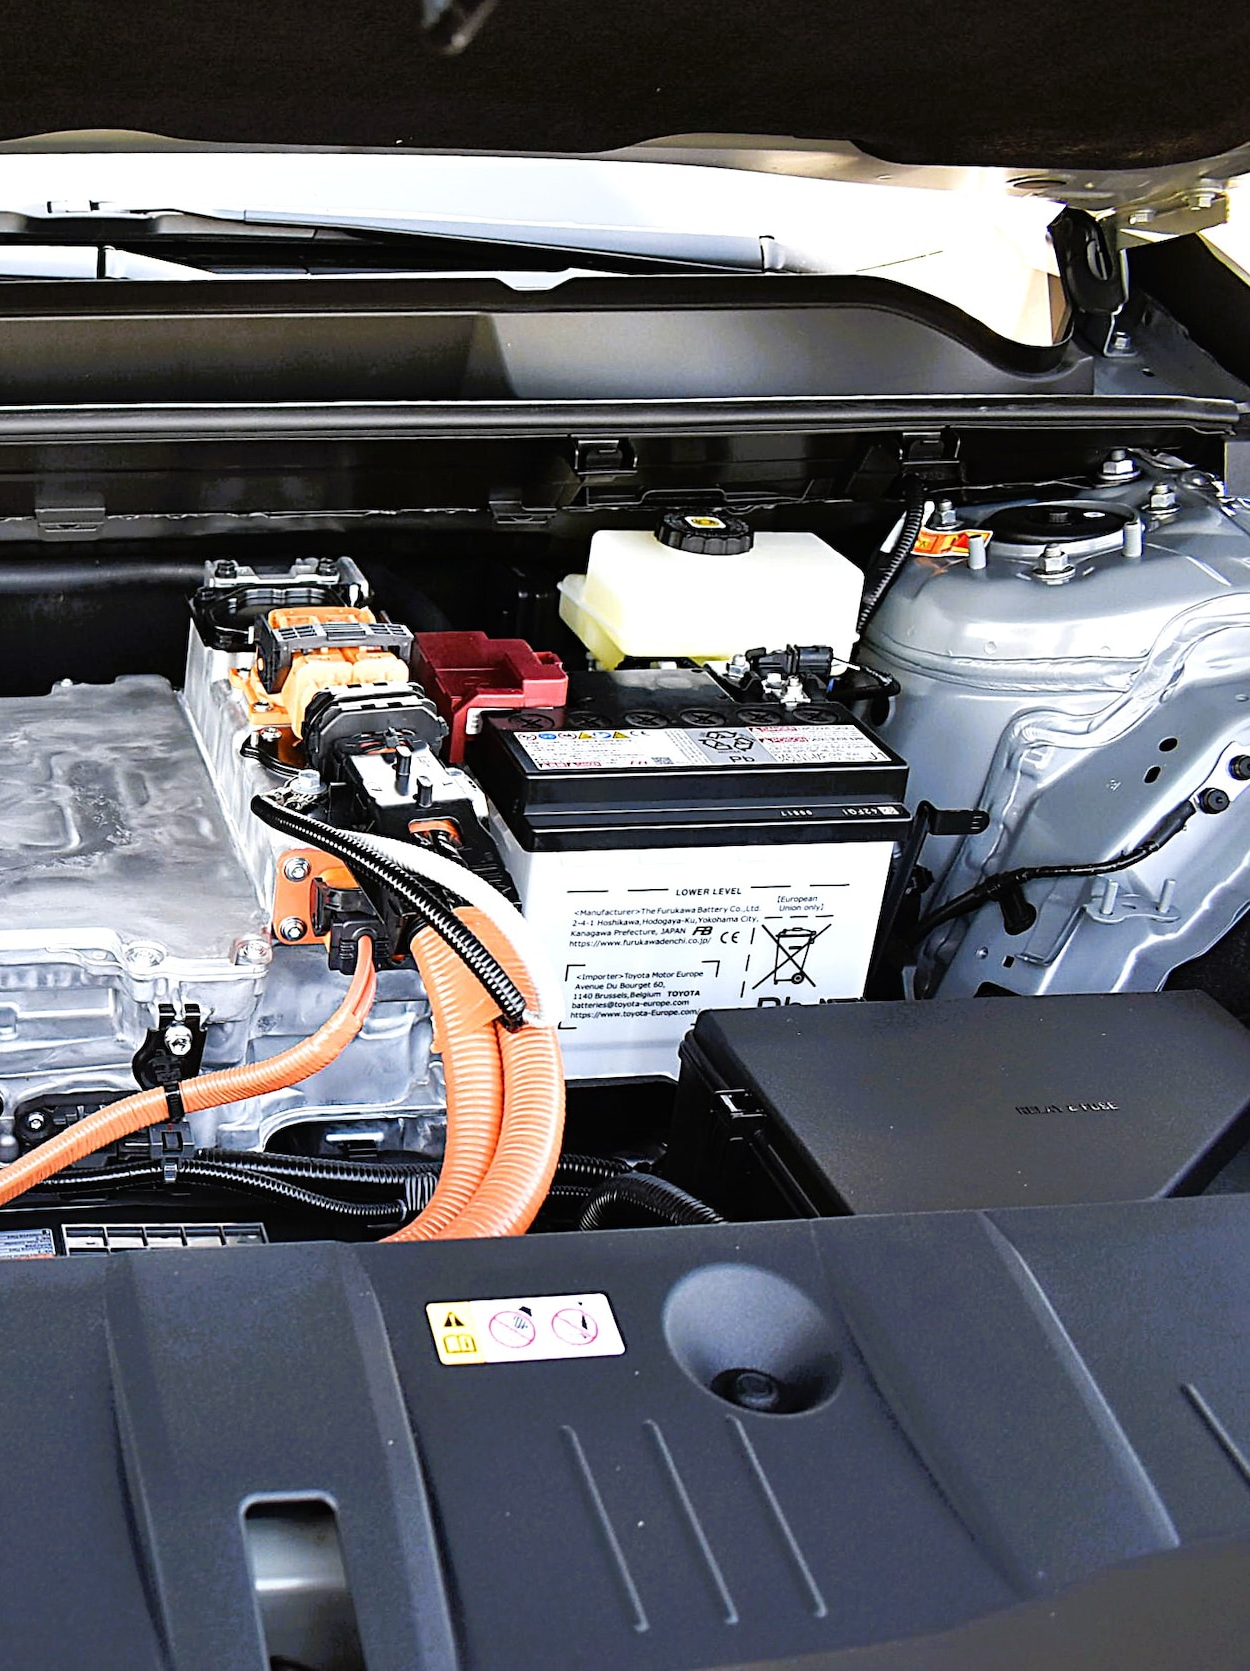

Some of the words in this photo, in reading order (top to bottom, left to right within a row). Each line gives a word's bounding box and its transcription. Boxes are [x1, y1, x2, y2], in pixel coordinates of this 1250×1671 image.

[729, 755, 755, 763] Pb
[720, 931, 740, 944] CE
[676, 971, 704, 979] Europe
[620, 982, 651, 990] Bourget
[572, 1000, 690, 1009] batteries@toyota-europe.com
[1079, 1101, 1119, 1111] FUSE
